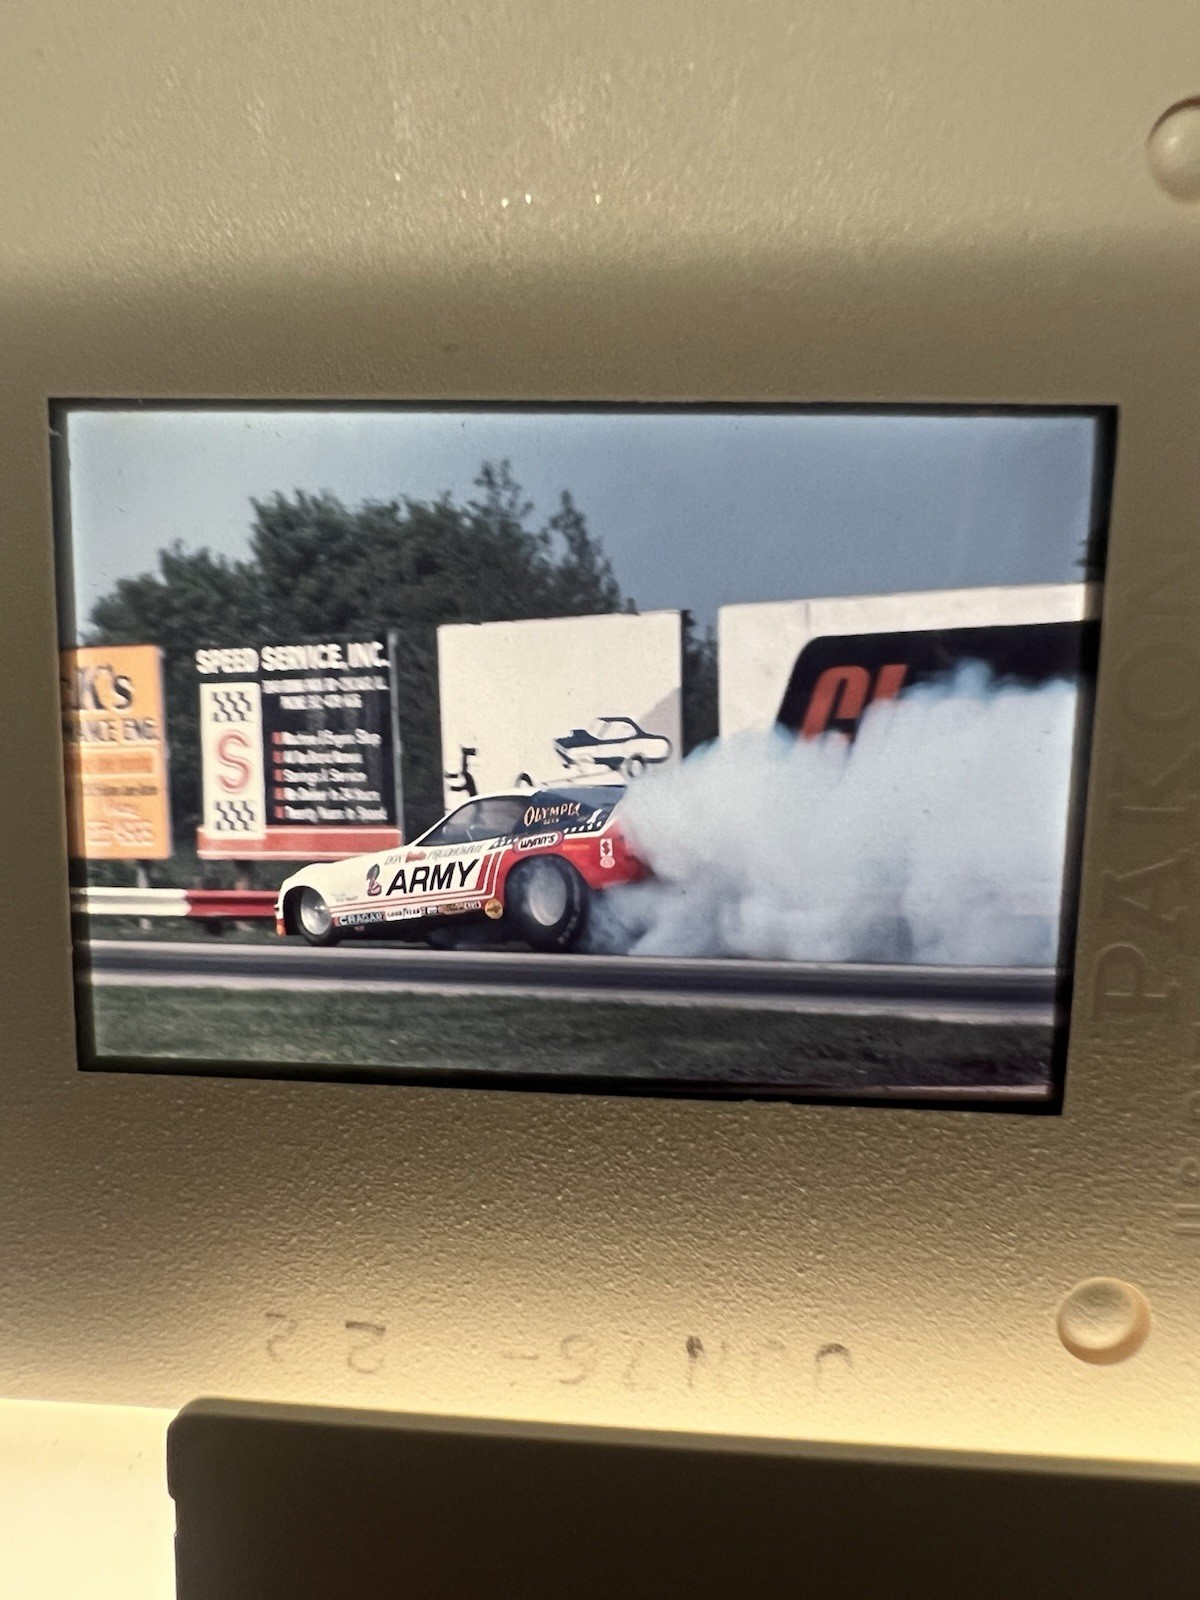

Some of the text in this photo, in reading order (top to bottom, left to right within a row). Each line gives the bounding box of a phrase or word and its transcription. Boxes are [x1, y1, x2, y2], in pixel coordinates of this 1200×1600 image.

[196, 647, 259, 674] SPEED
[216, 728, 251, 793] S
[385, 858, 480, 896] ARMY
